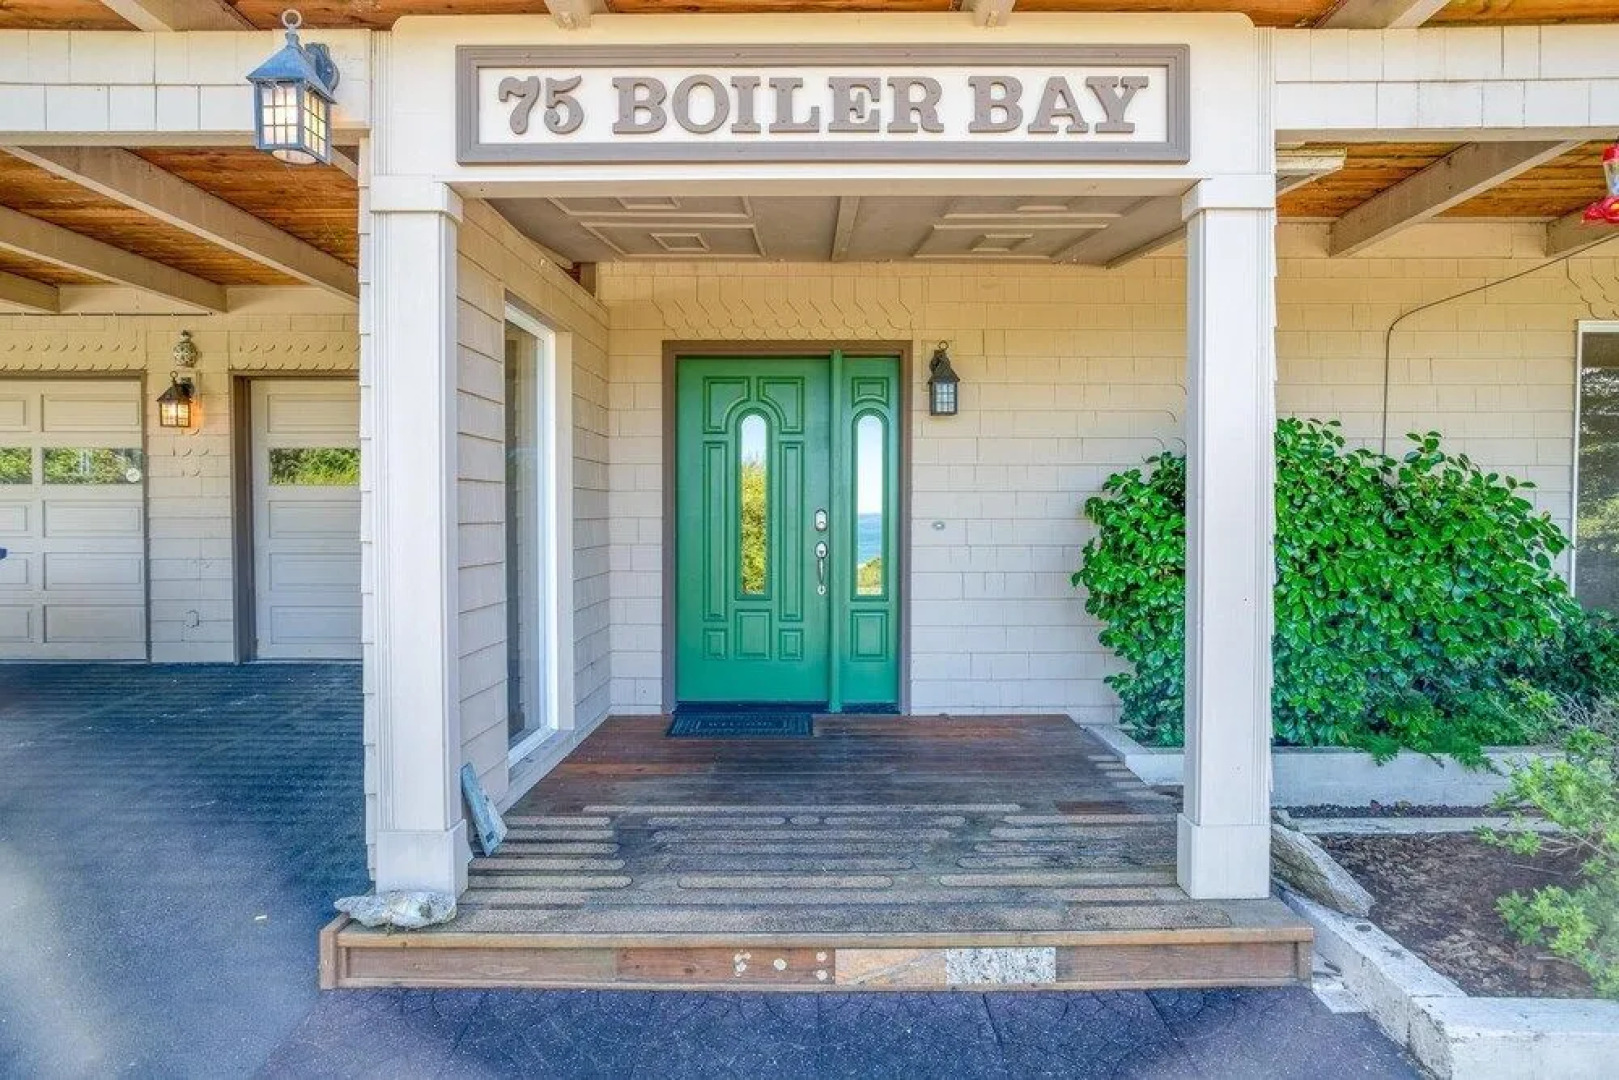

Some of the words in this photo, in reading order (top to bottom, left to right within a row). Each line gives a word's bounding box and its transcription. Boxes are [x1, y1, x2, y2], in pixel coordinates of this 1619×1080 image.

[498, 75, 585, 135] 75
[611, 75, 945, 135] BOILER
[967, 75, 1149, 135] BAY
